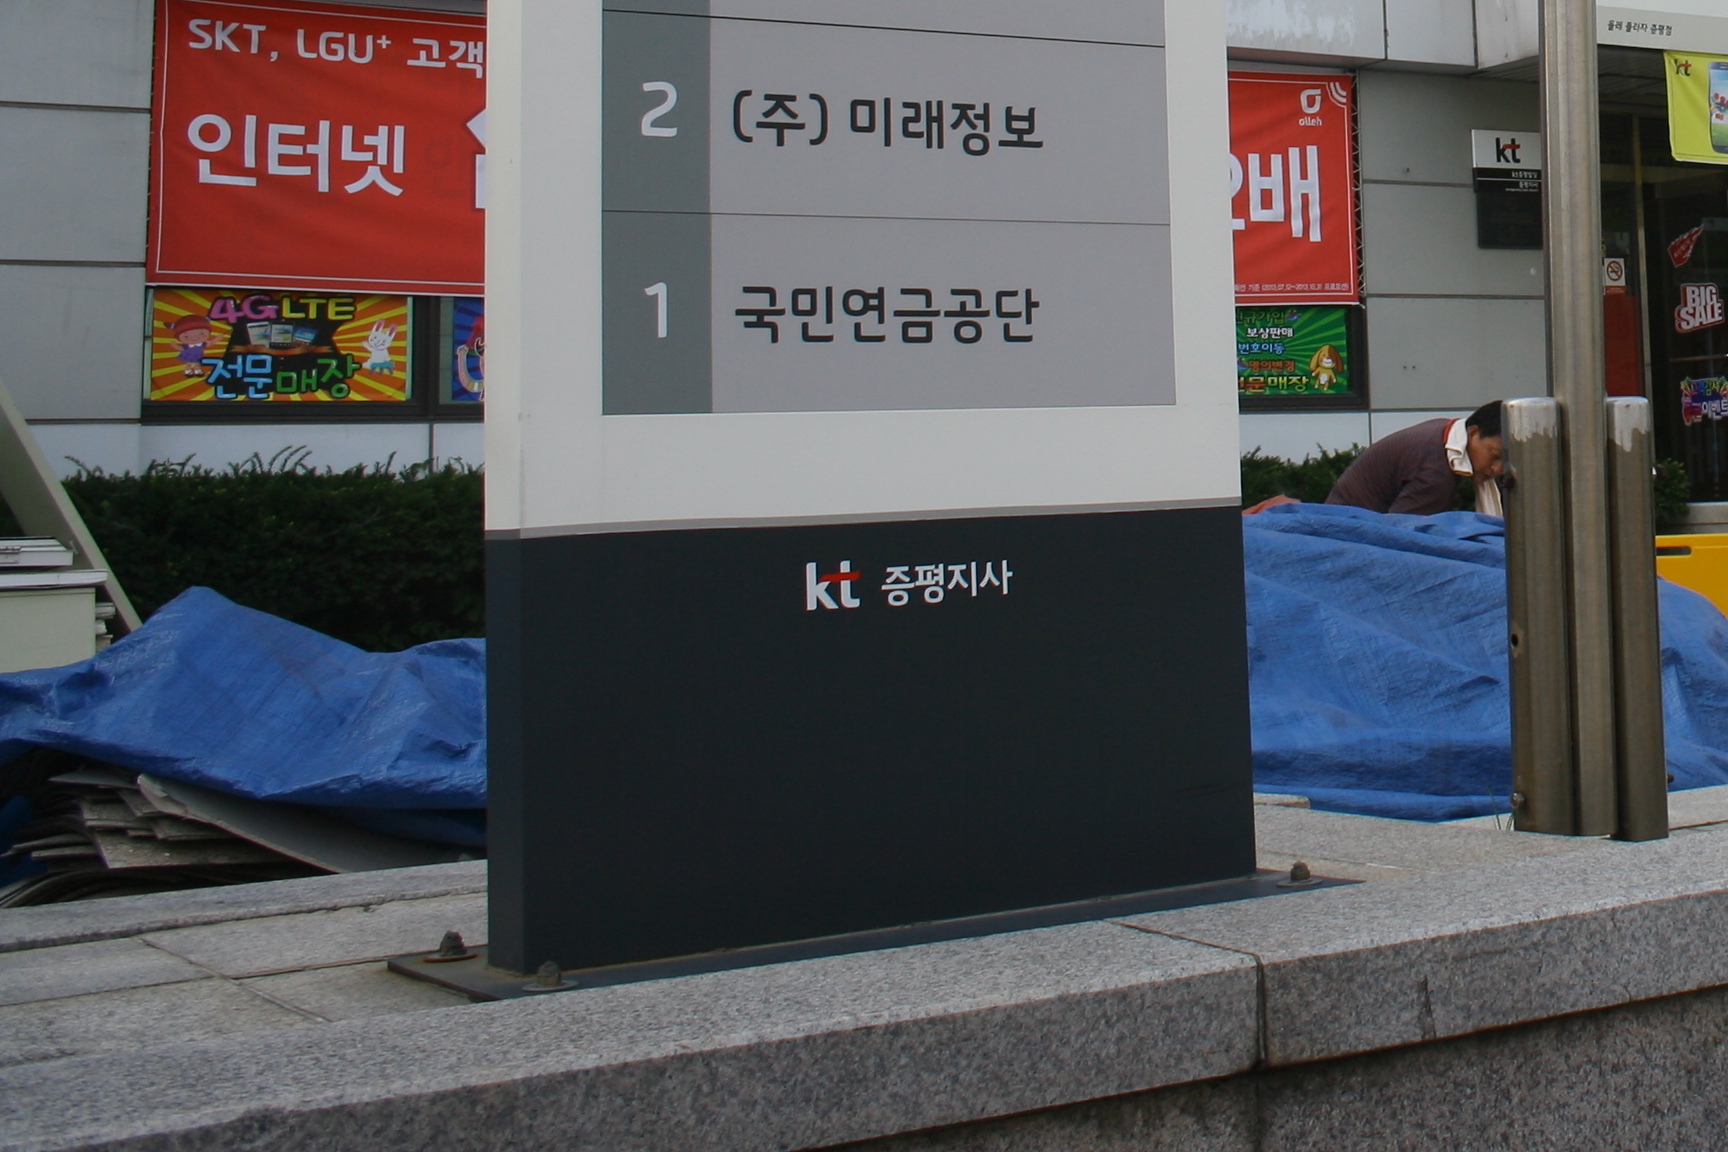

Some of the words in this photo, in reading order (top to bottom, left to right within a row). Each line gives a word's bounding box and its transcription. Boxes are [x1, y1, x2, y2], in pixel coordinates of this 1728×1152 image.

[188, 18, 280, 63] SKT,
[296, 28, 393, 64] LGU+
[407, 38, 485, 78] 고객
[1674, 58, 1692, 77] kt
[641, 81, 678, 138] 2
[733, 90, 829, 147] (주)
[850, 97, 1044, 156] 미래정보
[187, 113, 406, 197] 인터넷
[1495, 137, 1521, 163] kt
[644, 282, 668, 338] 1
[735, 286, 1040, 344] 국민연금공단
[1686, 285, 1718, 308] BIG
[1246, 328, 1294, 339] 보상판매
[1679, 301, 1723, 330] SALE
[1238, 343, 1285, 355] 번호이동
[201, 353, 361, 399] 전문매장
[805, 559, 861, 611] kt
[880, 559, 1013, 607] 증평지사
